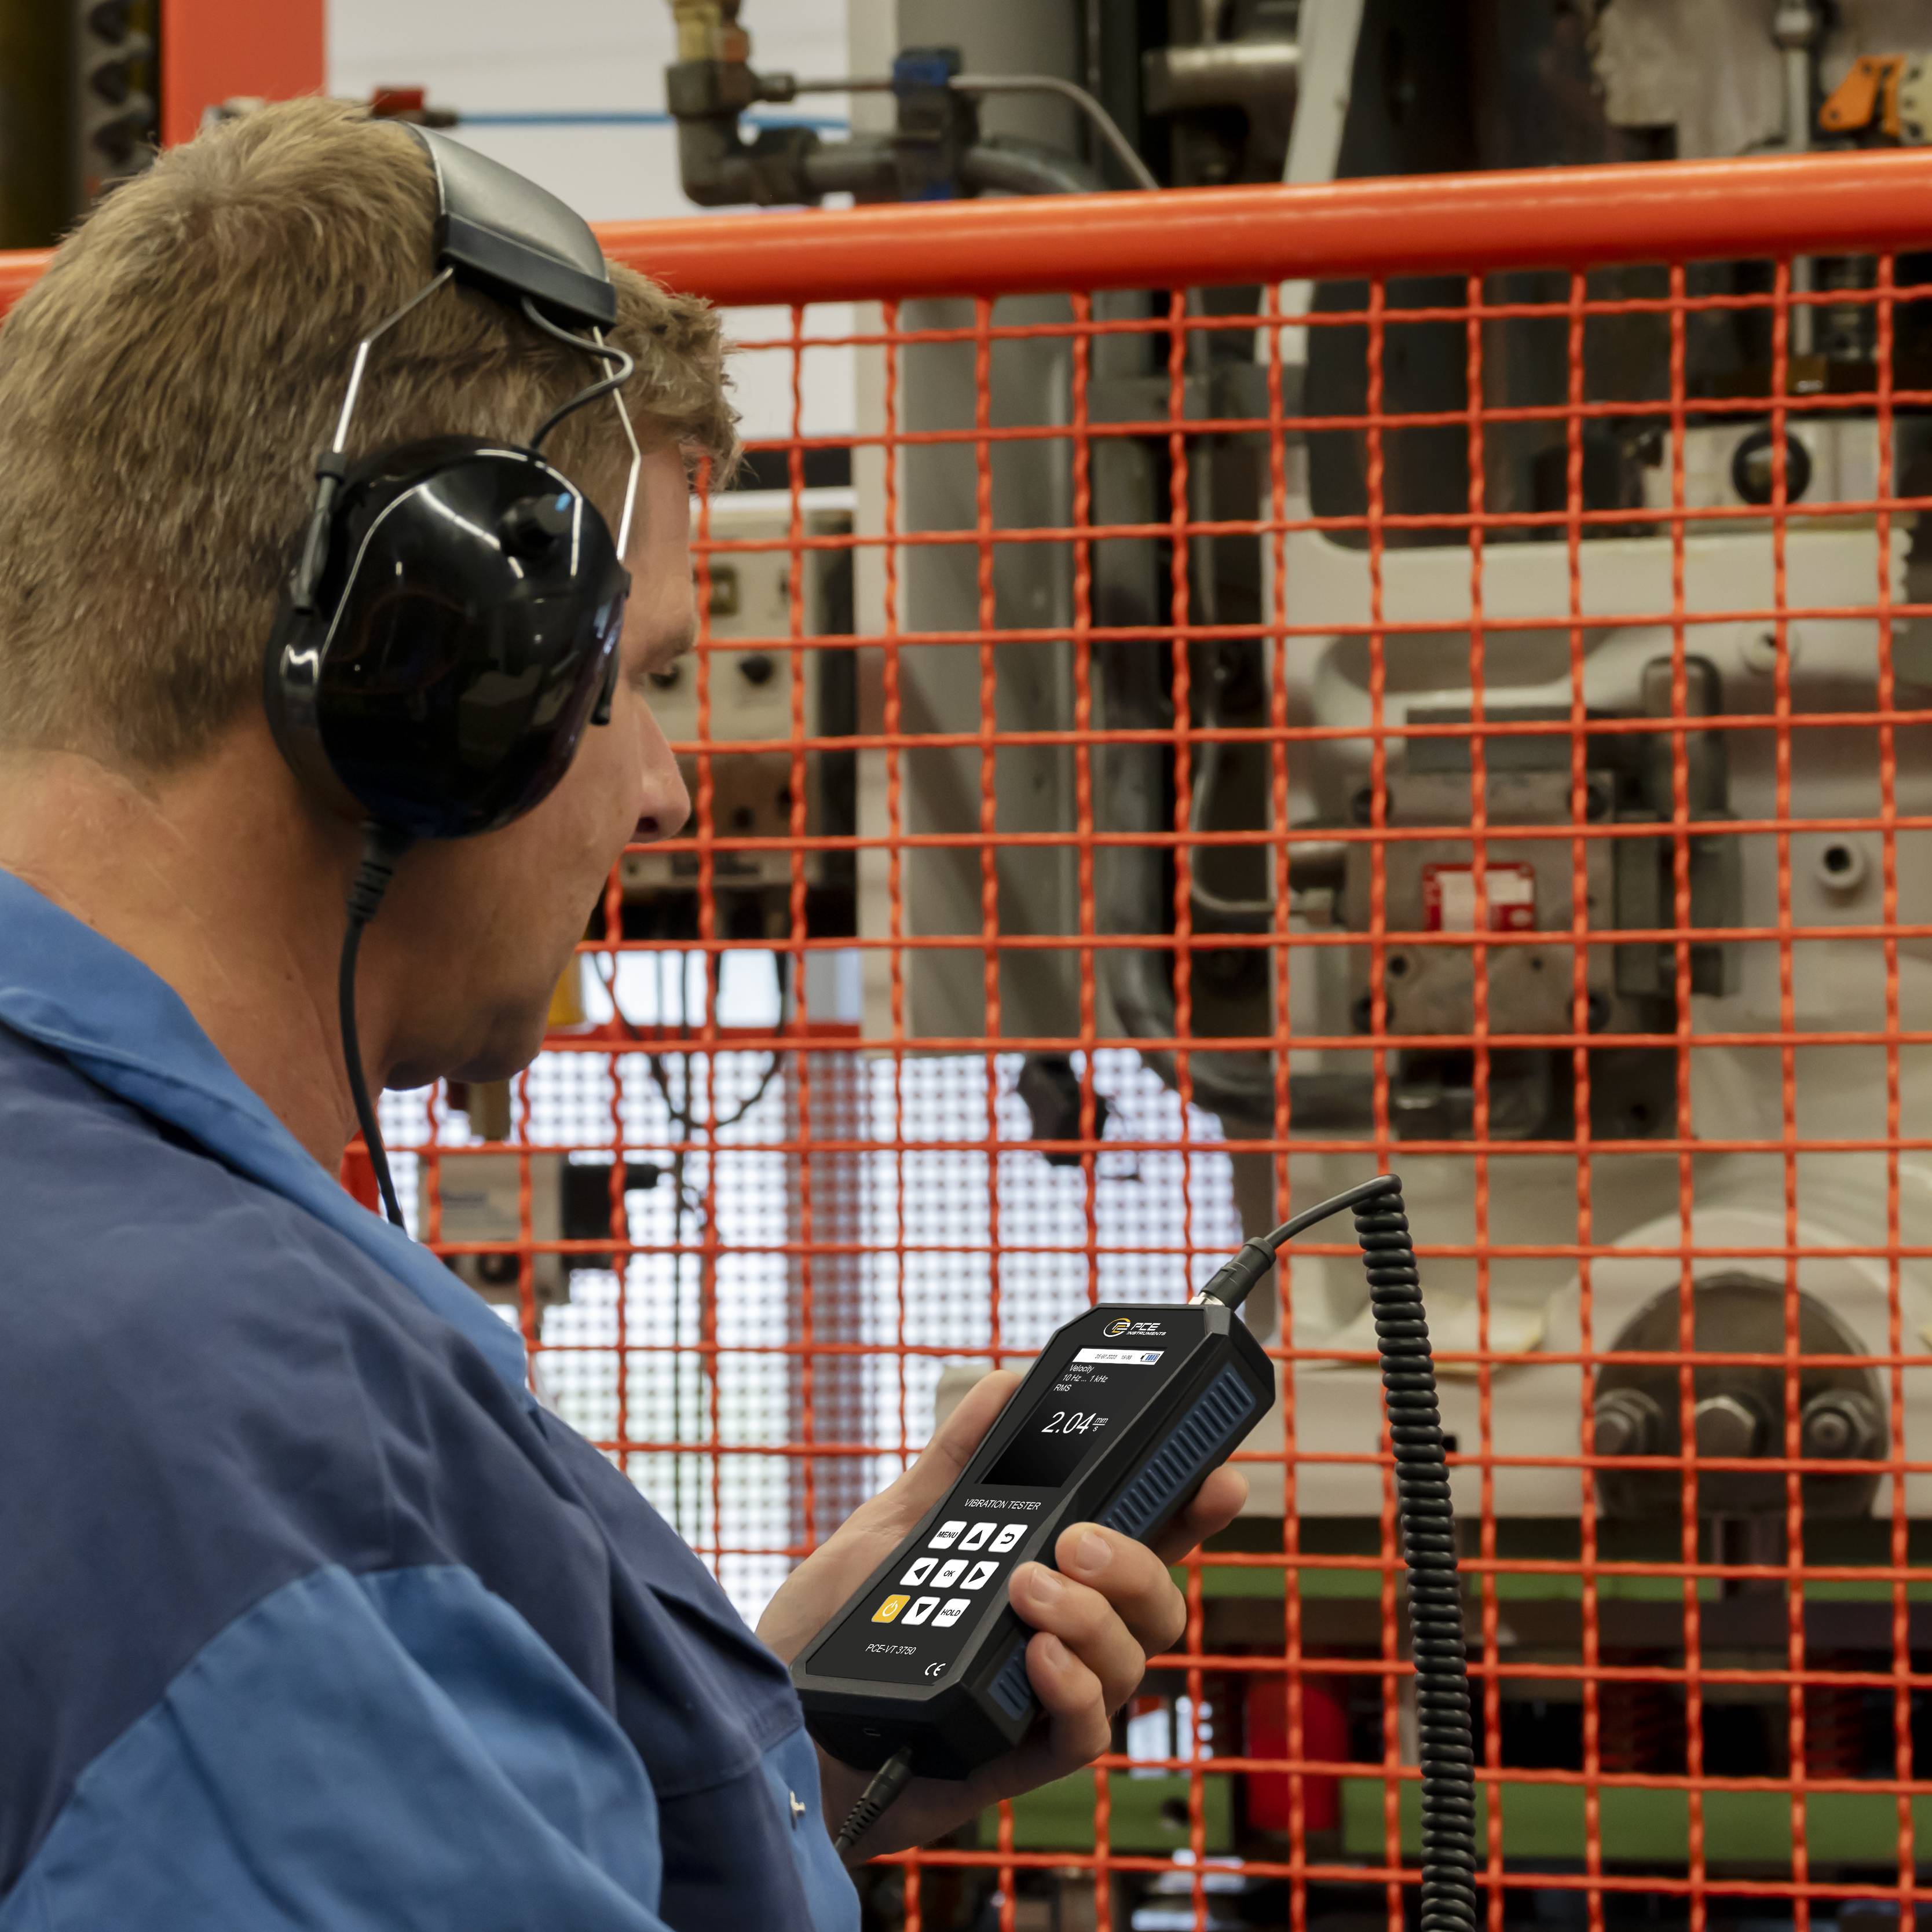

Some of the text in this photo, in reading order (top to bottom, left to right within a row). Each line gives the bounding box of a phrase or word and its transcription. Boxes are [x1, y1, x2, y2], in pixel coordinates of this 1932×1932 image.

[1130, 1322, 1161, 1331] PCE
[1070, 1364, 1095, 1374] Velocity
[1053, 1384, 1072, 1392] RMS
[1041, 1411, 1097, 1435] 2.04
[964, 1498, 1041, 1510] VIBRATION TESTER
[865, 1644, 917, 1655] PCE-VT 3750
